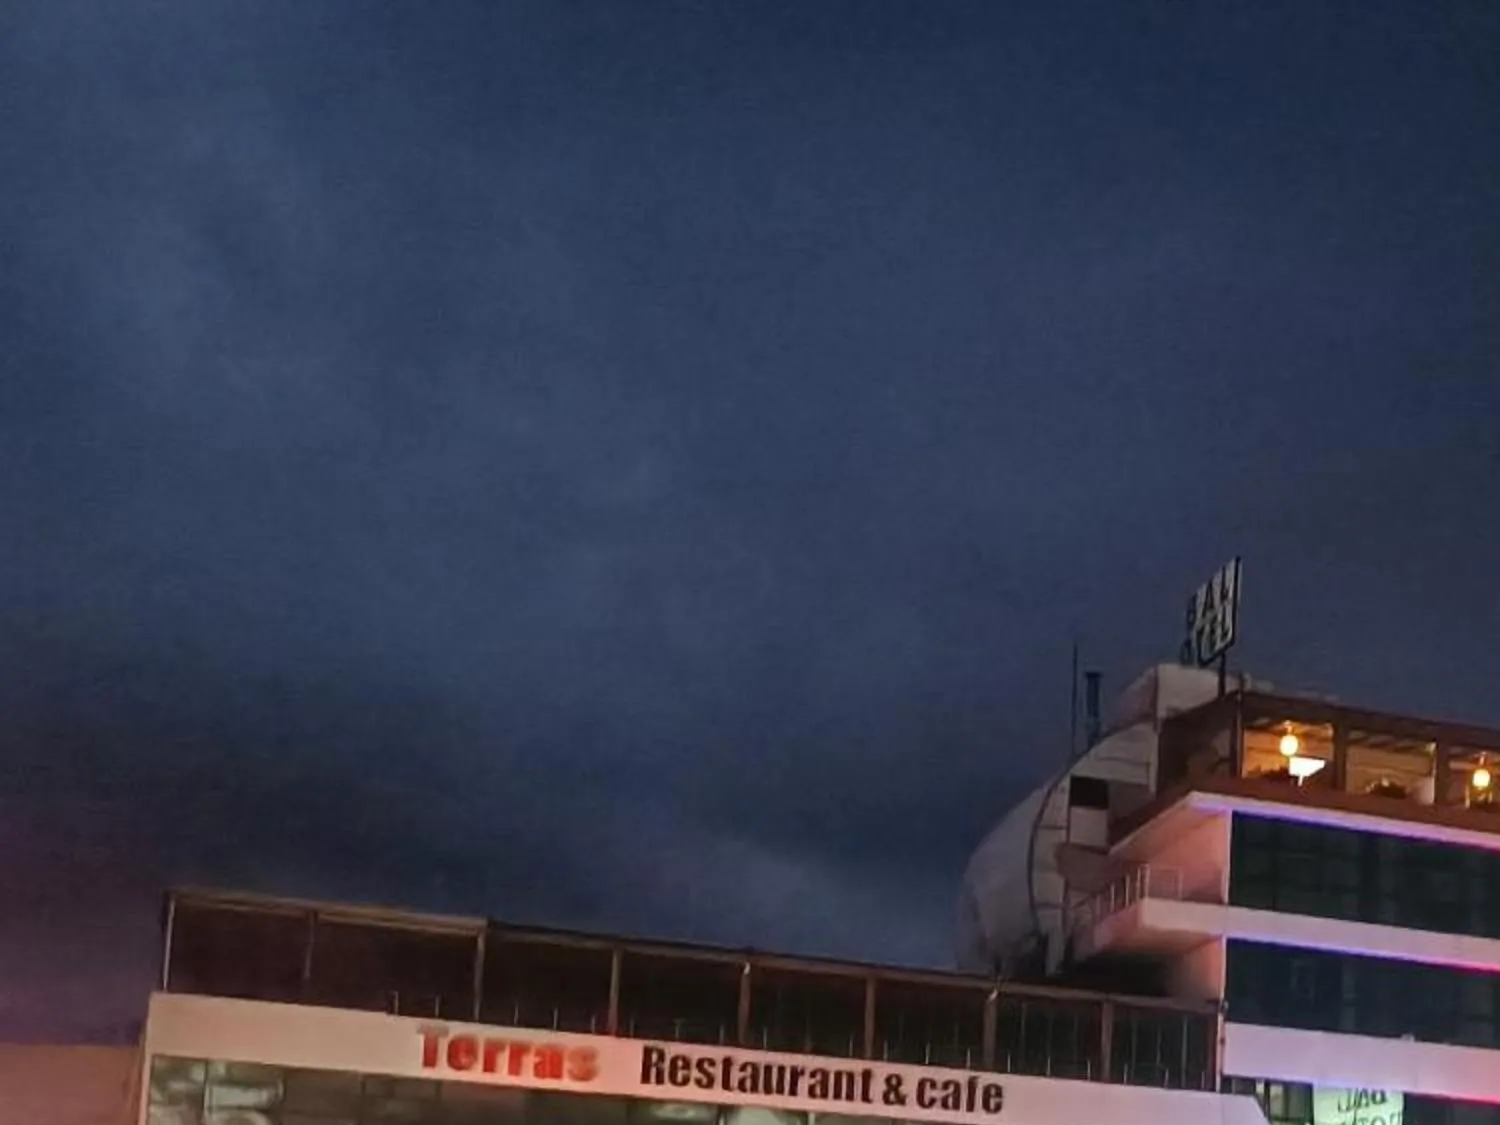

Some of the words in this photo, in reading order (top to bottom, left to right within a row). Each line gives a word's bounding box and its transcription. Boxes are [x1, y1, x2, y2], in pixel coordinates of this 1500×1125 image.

[416, 1023, 600, 1082] Terras
[640, 1045, 873, 1104] Restaurant
[882, 1073, 907, 1106] &
[915, 1075, 1003, 1114] cafe
